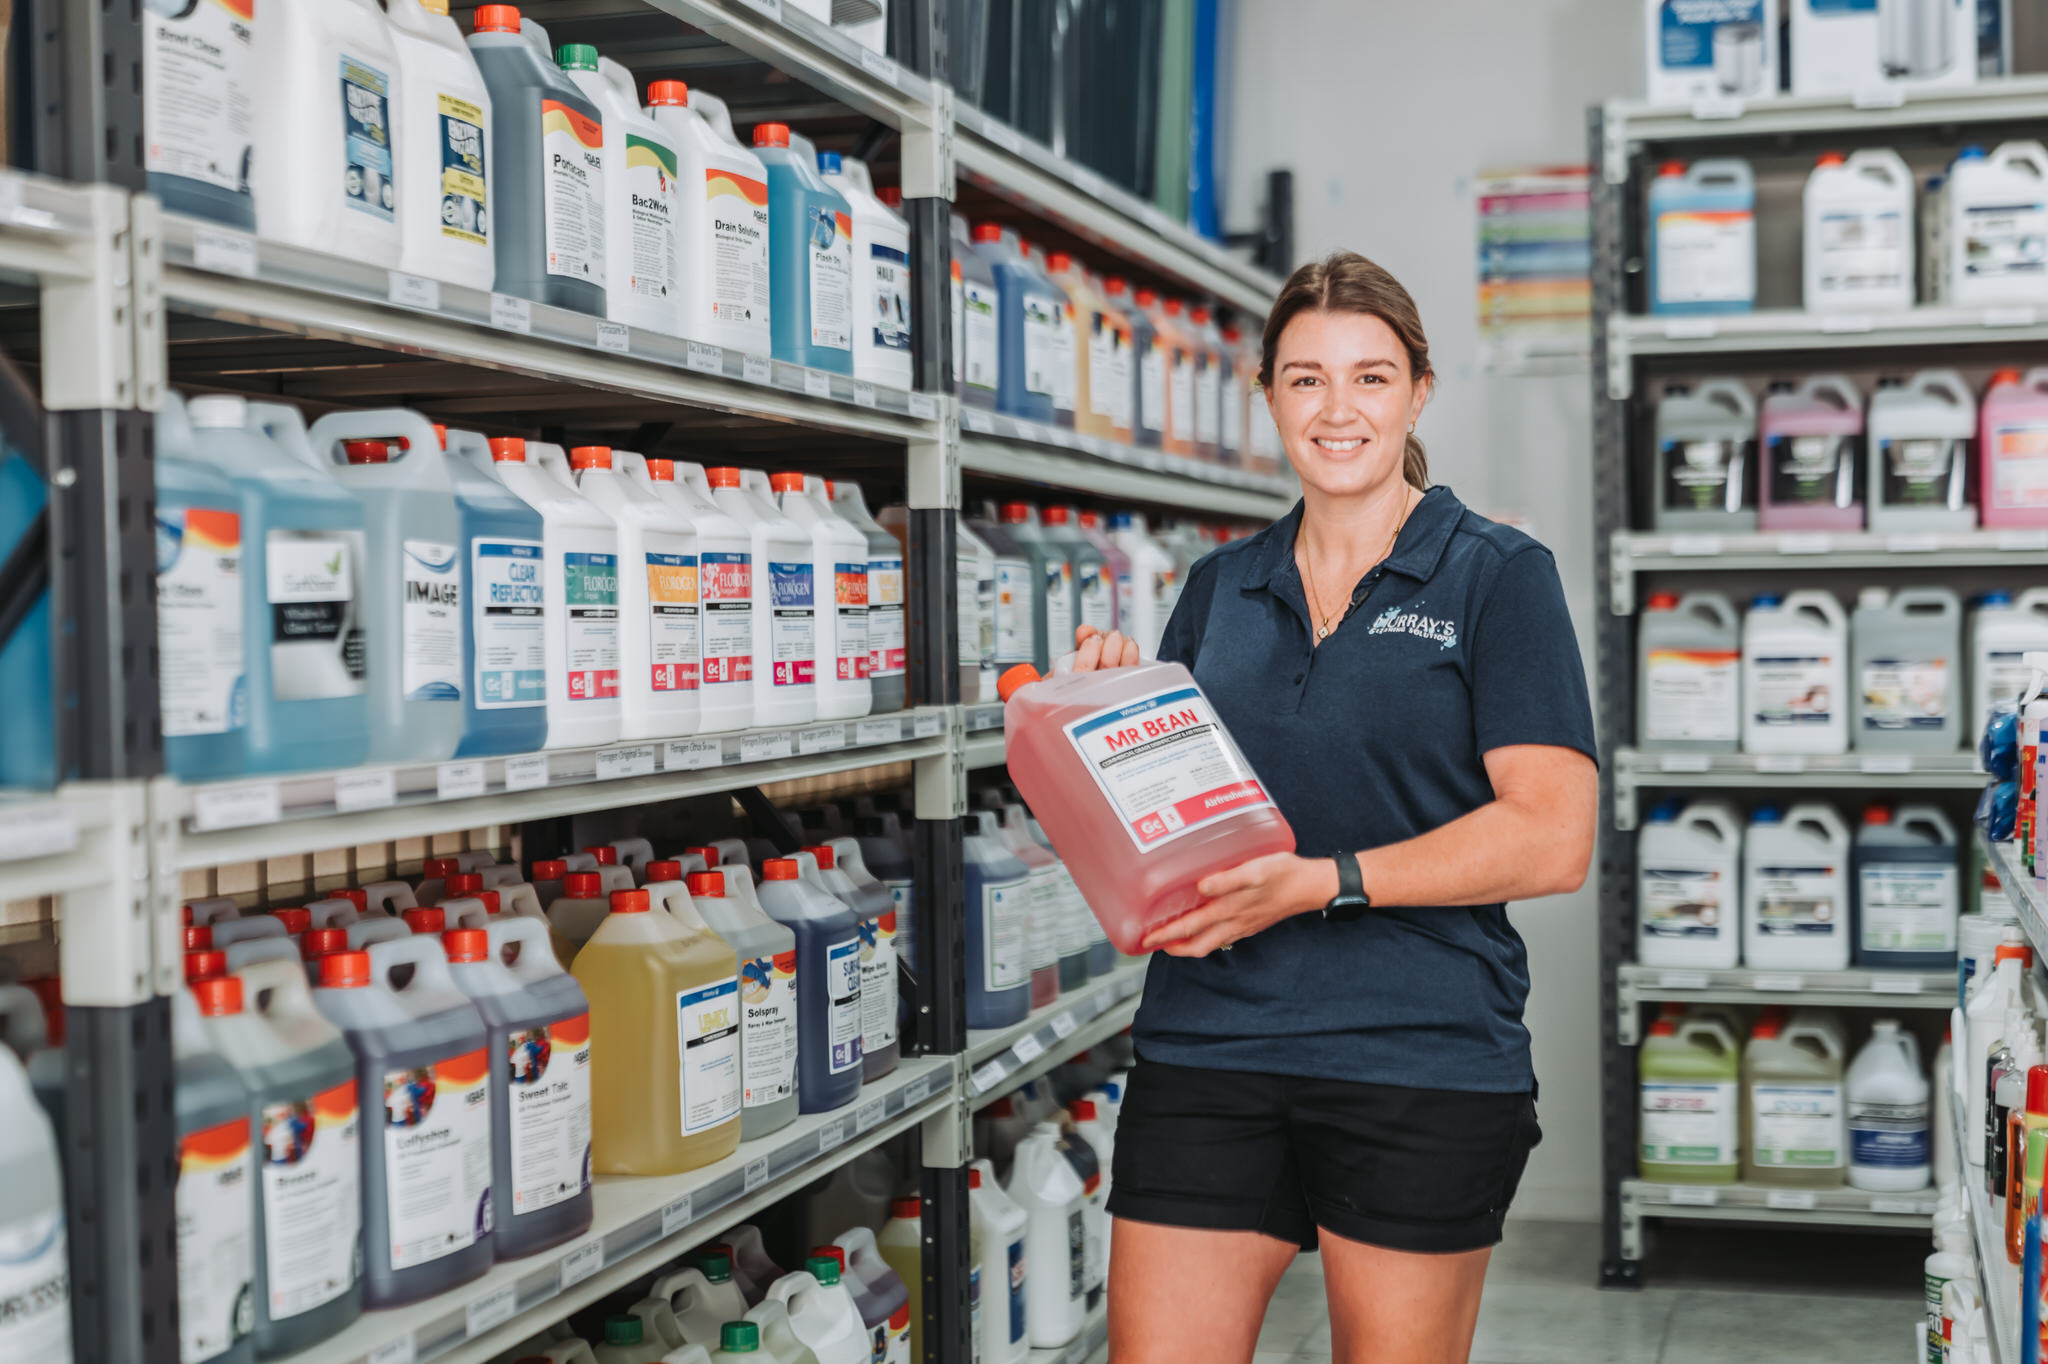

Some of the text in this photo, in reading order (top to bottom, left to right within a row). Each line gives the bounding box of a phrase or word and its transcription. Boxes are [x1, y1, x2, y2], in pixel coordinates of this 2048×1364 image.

[553, 154, 587, 179] Portacare
[632, 194, 669, 215] Bac2Work
[715, 219, 760, 240] Drain Solution
[508, 562, 536, 582] CLEAR
[406, 581, 458, 607] IMAGE
[1373, 613, 1455, 636] MURRAY'S
[1104, 708, 1200, 752] MR BEAN
[1141, 818, 1163, 835] Gc
[747, 1007, 779, 1018] Solspray
[519, 1082, 569, 1102] Sweet Talc
